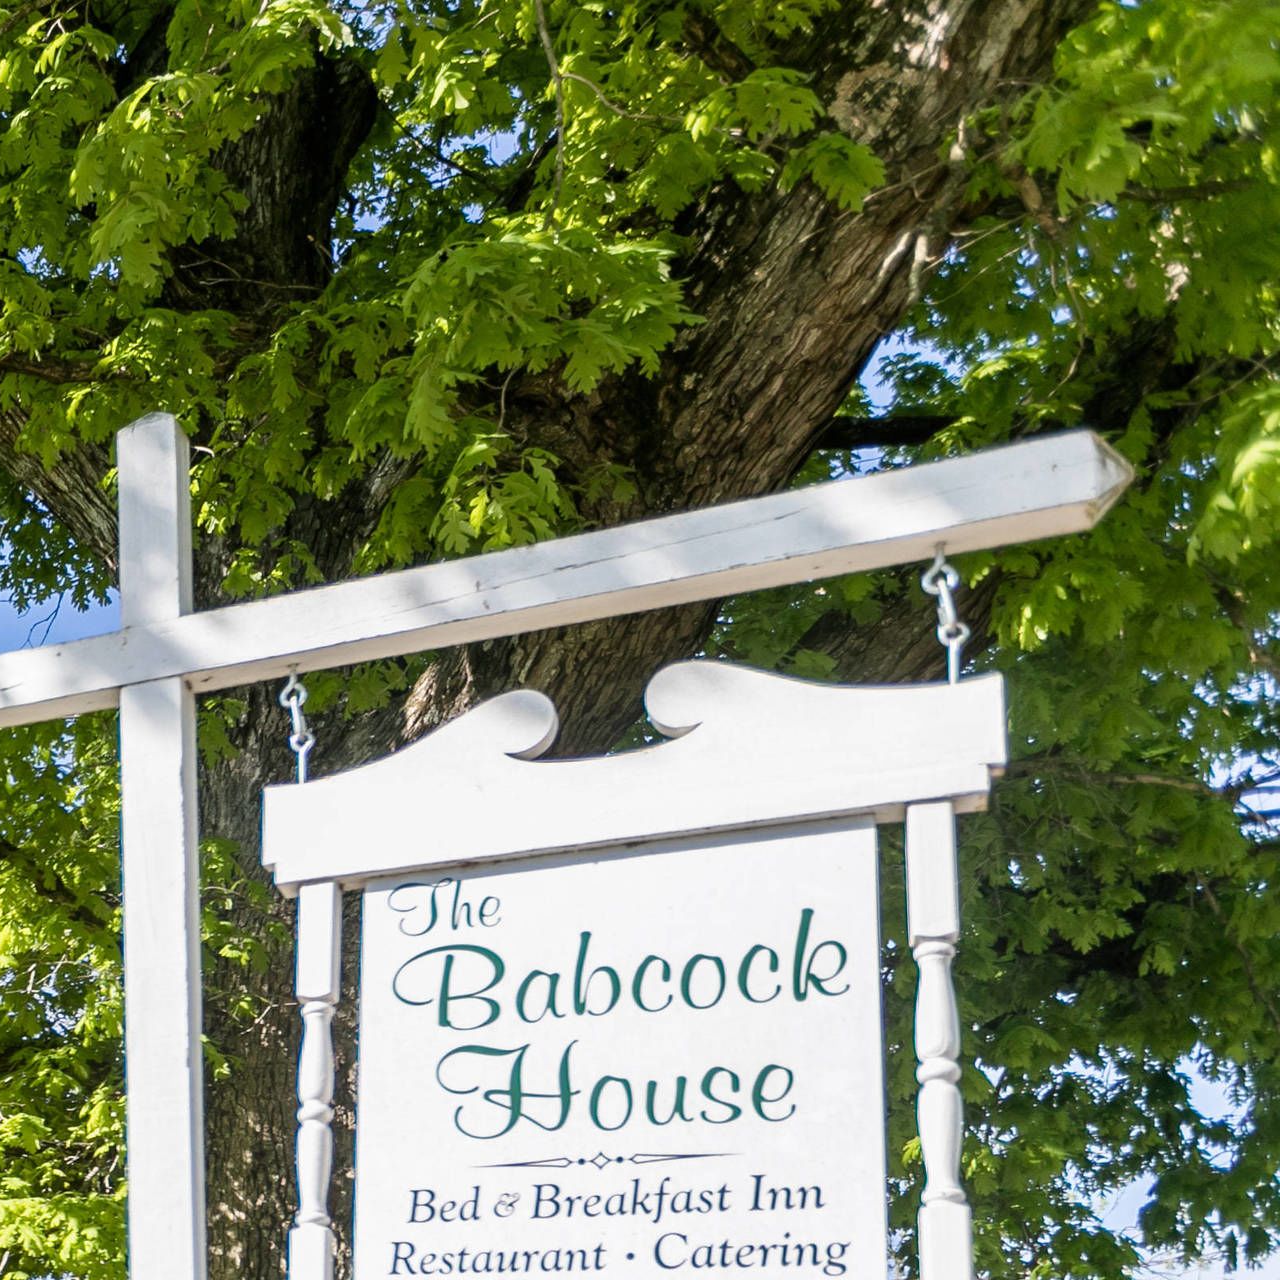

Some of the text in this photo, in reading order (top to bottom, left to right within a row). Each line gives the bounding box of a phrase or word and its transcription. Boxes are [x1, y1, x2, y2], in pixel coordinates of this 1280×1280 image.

[387, 876, 503, 937] The
[392, 907, 851, 1031] Babcock
[436, 1039, 797, 1140] House
[407, 1174, 825, 1225] Bed & Breakfast Inn
[389, 1231, 850, 1276] Restaurant Catering
